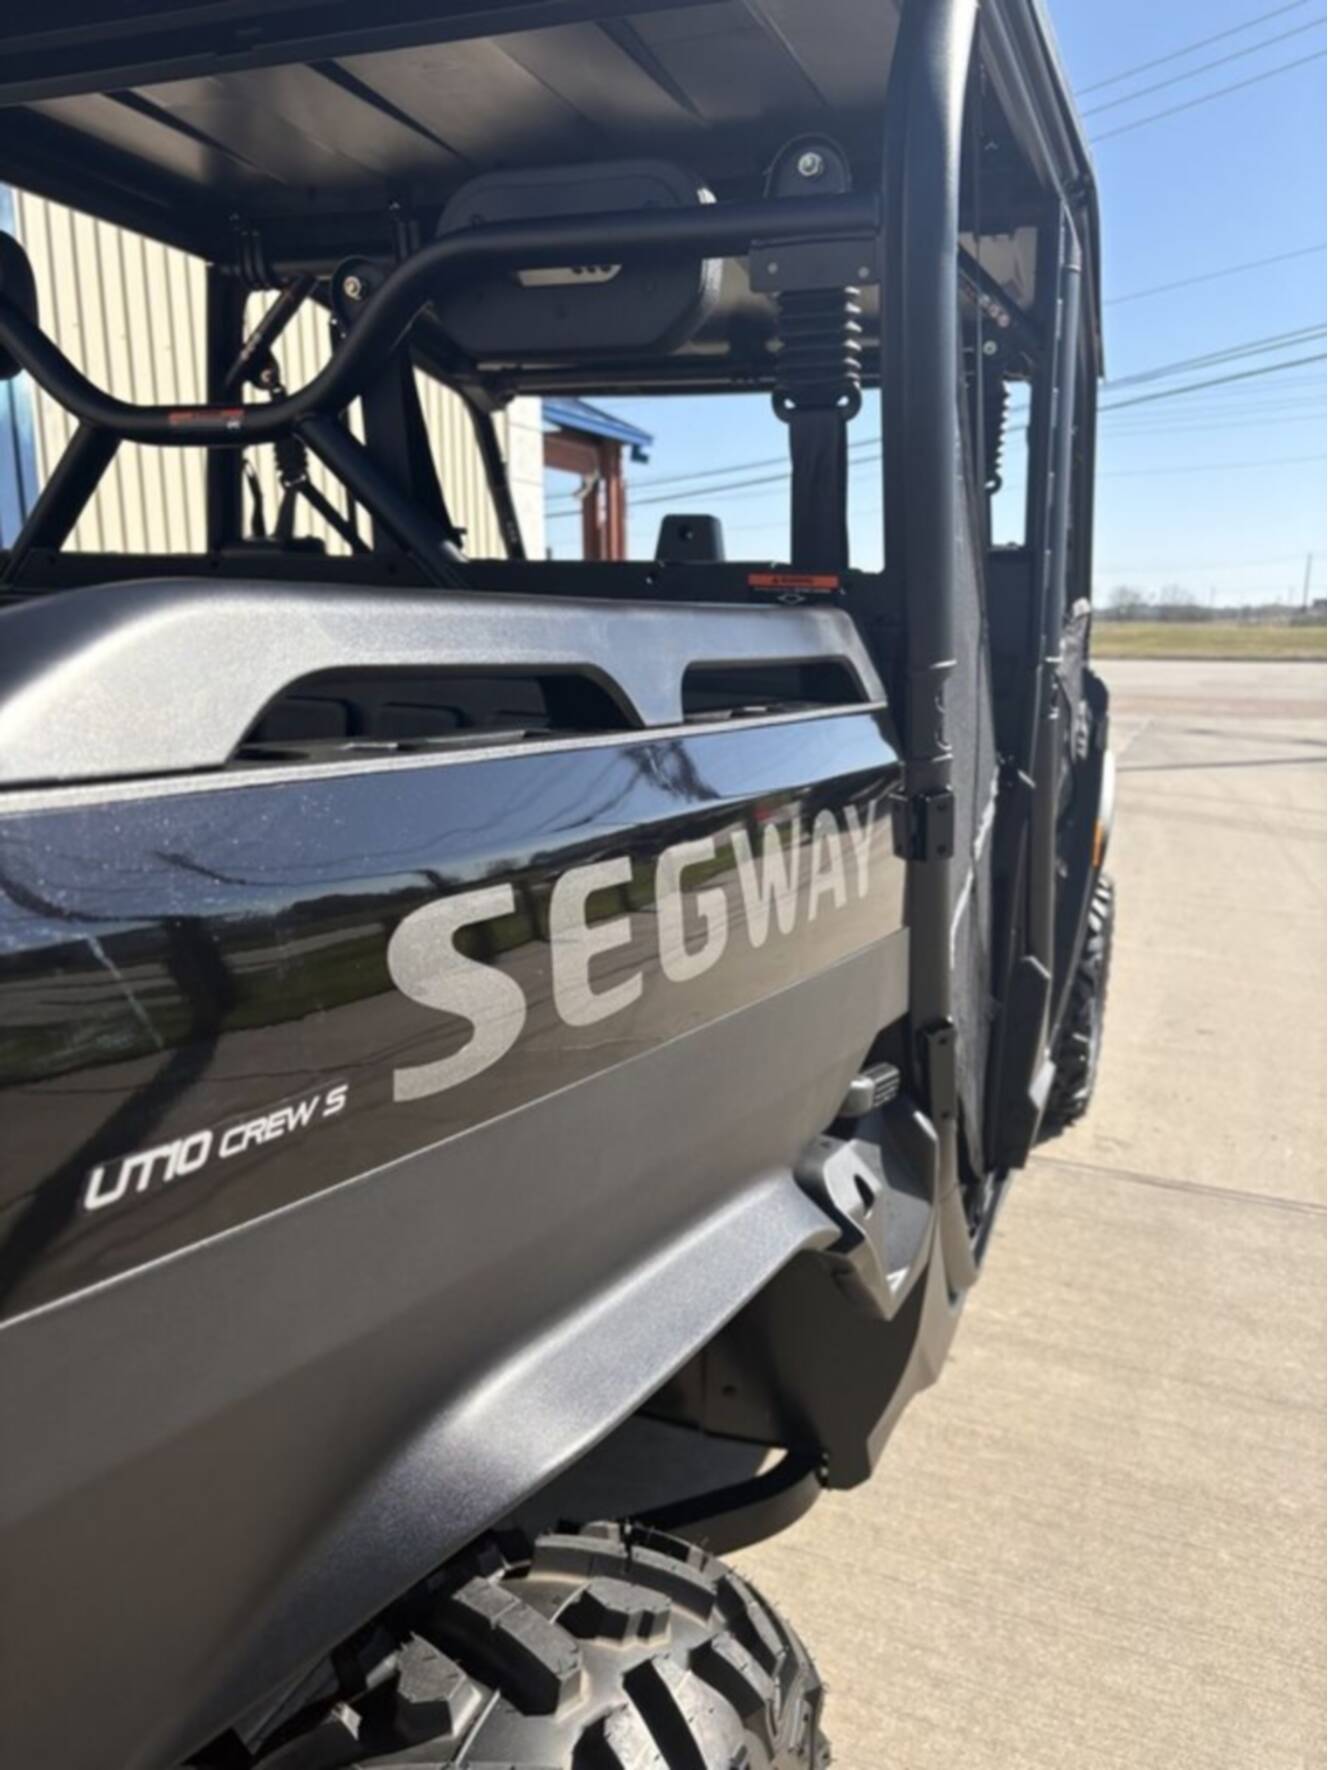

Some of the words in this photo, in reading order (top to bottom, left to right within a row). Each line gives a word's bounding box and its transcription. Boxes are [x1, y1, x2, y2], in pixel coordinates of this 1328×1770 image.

[387, 800, 877, 1103] SEGWAY
[84, 1130, 213, 1211] UT10
[219, 1096, 320, 1158] CREW
[322, 1084, 349, 1117] S
